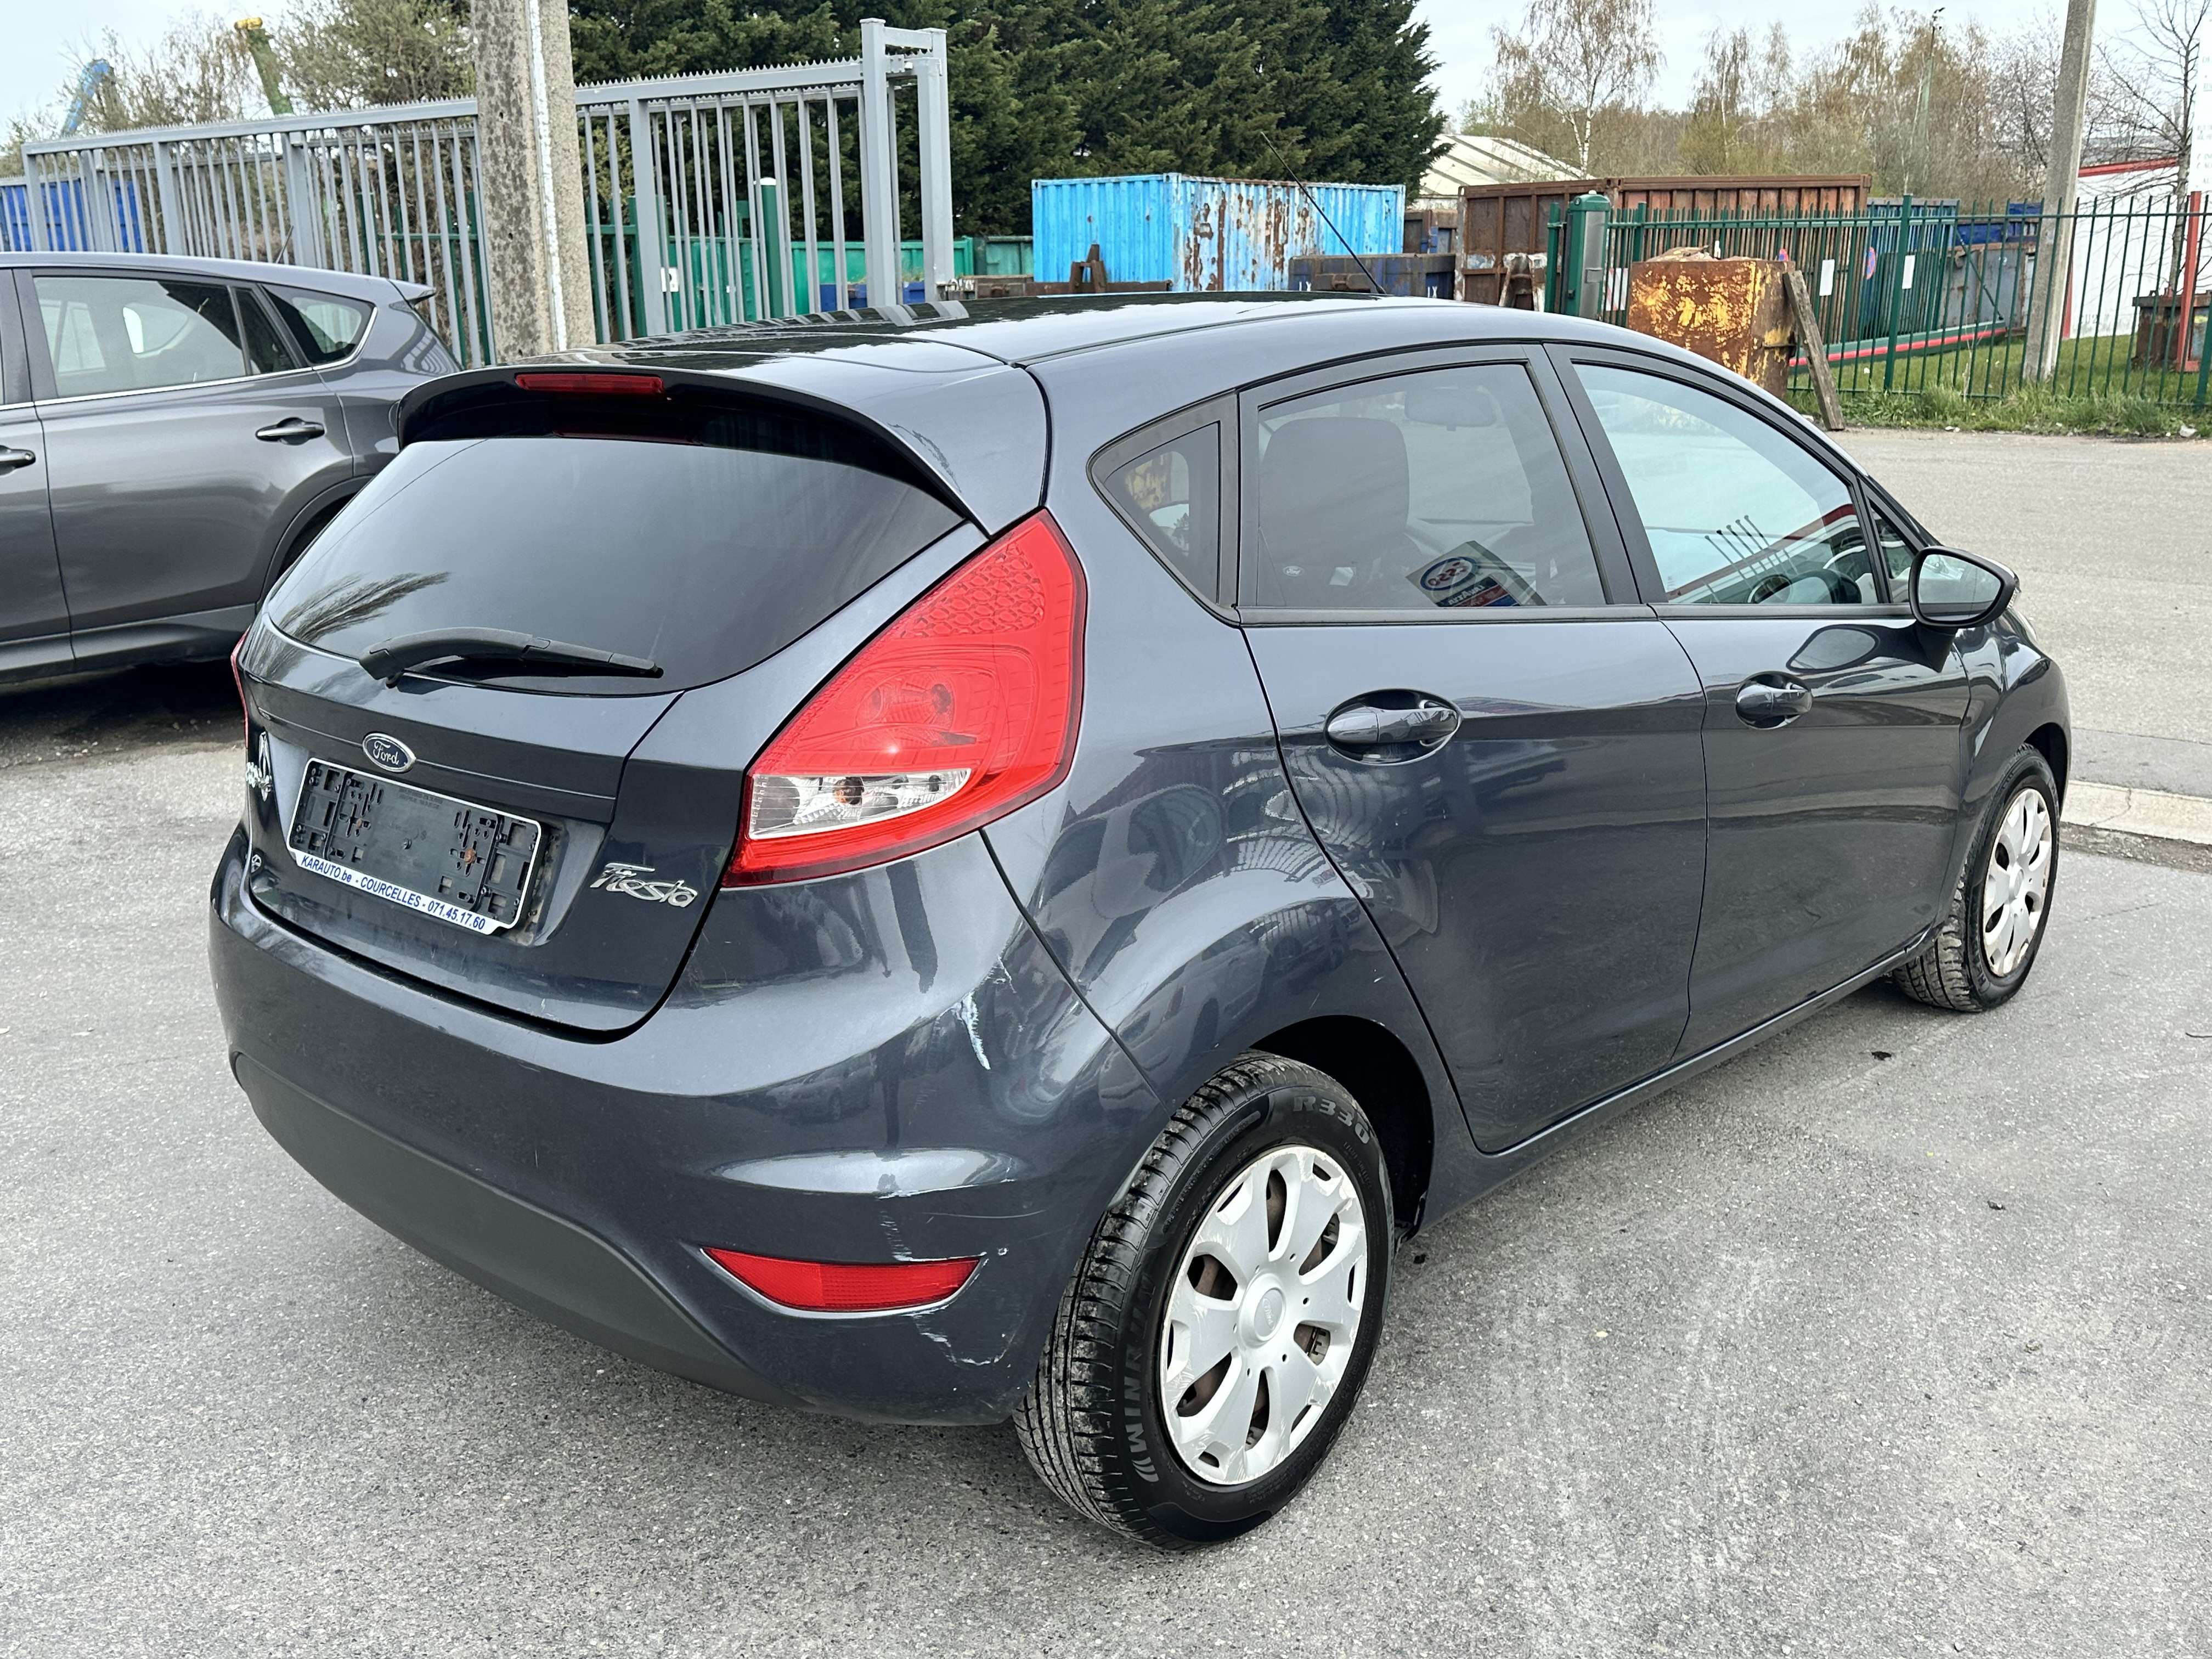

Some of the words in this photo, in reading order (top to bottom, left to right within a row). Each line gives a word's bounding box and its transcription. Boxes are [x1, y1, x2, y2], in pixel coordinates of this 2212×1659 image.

[373, 740, 399, 765] Ford
[301, 855, 352, 883] KARAUTO.be
[360, 877, 422, 907] COURCELLES
[427, 900, 486, 930] 071.45.17.60
[590, 862, 698, 907] Fiesta
[1292, 1096, 1370, 1145] R330
